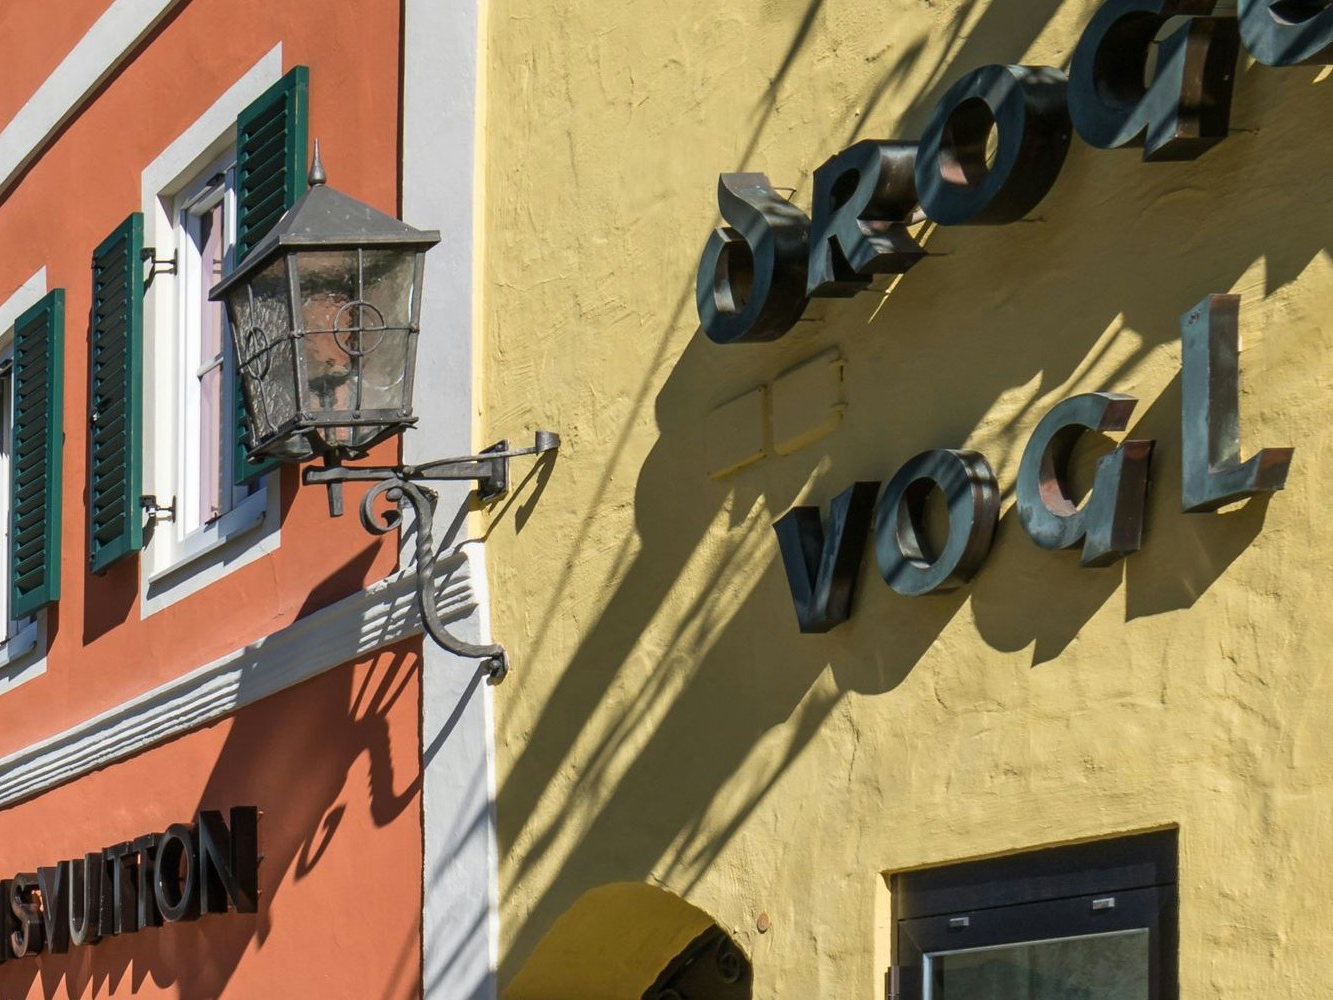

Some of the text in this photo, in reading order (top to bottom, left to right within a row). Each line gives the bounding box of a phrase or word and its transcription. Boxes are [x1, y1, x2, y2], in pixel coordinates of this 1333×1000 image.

[696, 0, 1333, 344] DROG
[773, 293, 1293, 634] VOGL
[37, 806, 258, 954] VUITTON
